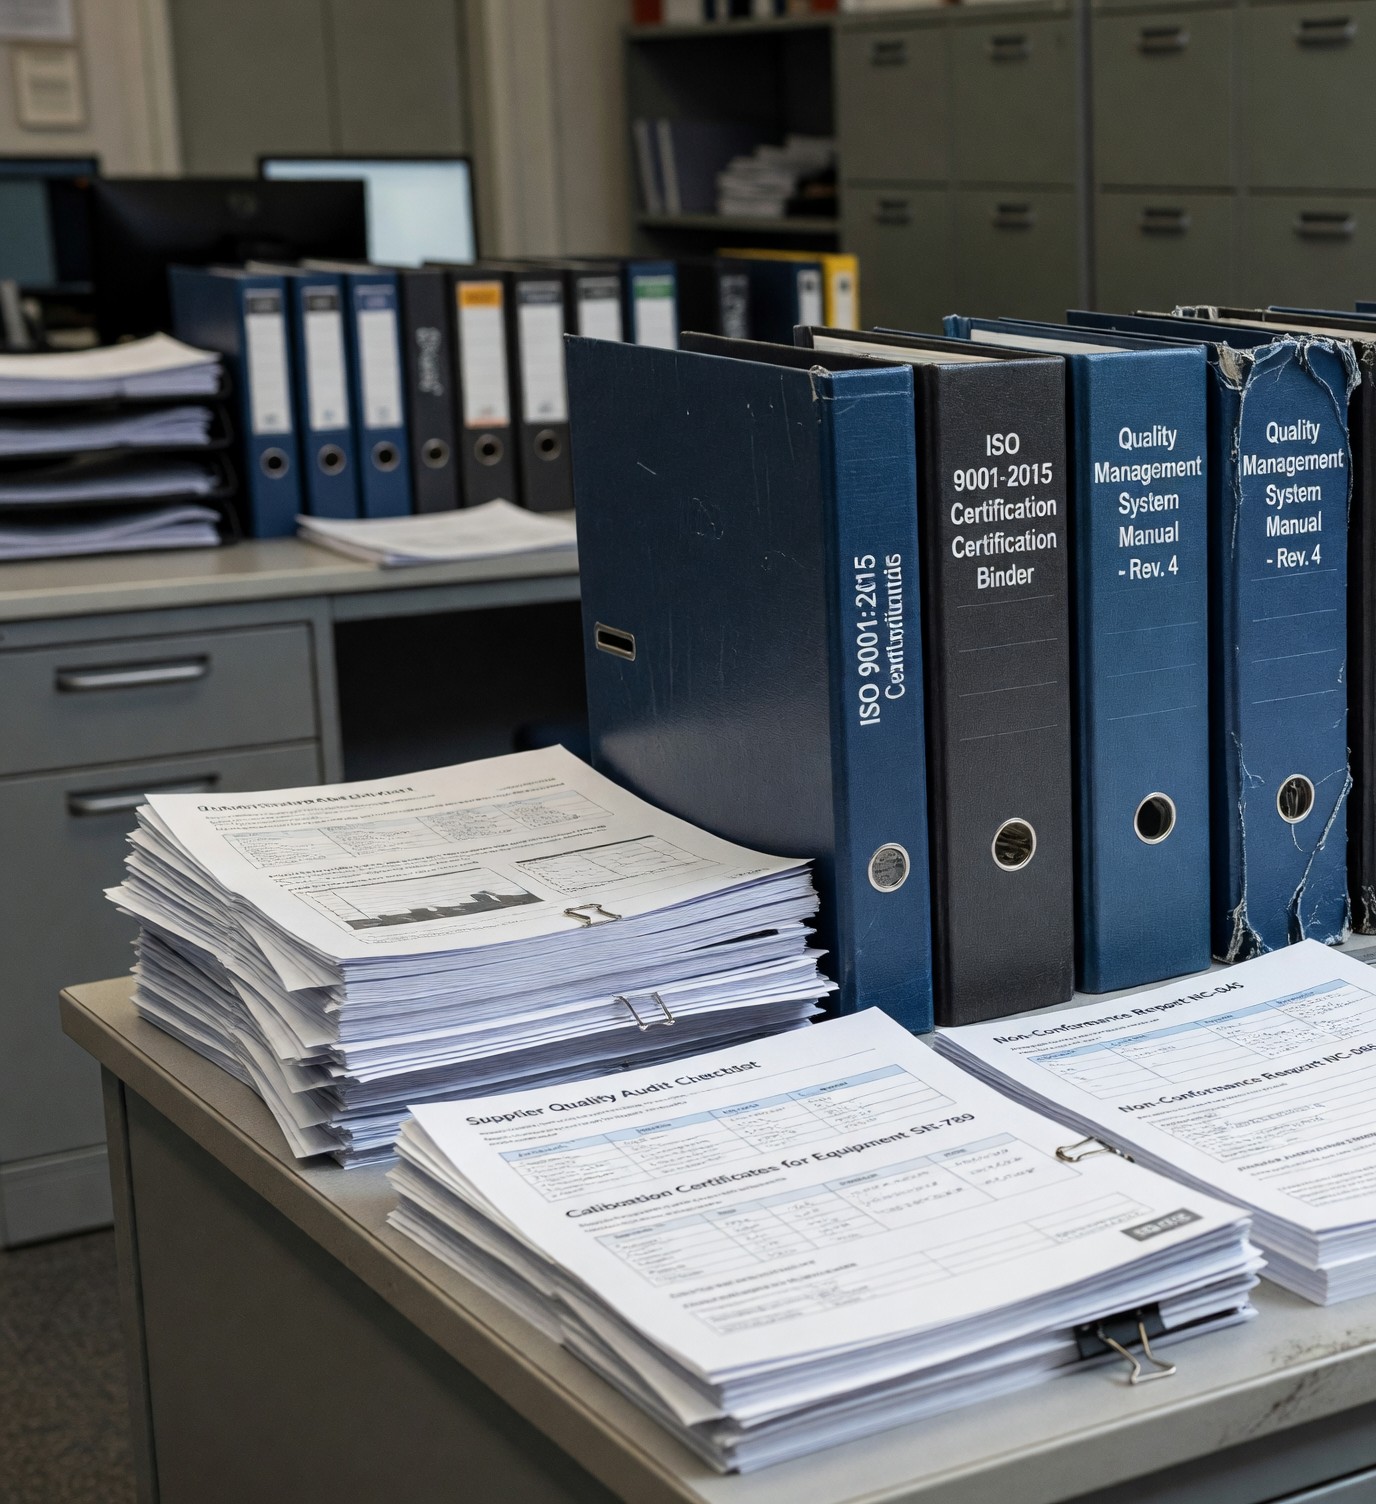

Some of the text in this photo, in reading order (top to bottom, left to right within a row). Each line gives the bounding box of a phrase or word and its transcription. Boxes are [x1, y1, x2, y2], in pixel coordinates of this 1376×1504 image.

[986, 433, 1020, 457] ISO
[1119, 425, 1177, 450] Quality
[1266, 419, 1320, 445] Quality
[1094, 455, 1202, 485] Management
[1243, 449, 1344, 477] Management
[953, 463, 1053, 492] 9001-2015
[1119, 490, 1179, 518] System
[1266, 484, 1321, 509] System
[951, 497, 1057, 525] Certification
[1266, 511, 1322, 537] Manual
[952, 529, 1057, 559] Certification
[1119, 521, 1179, 548] Manual
[1129, 559, 1165, 580] Rev.
[1168, 555, 1179, 576] 4
[1277, 547, 1309, 569] Rev.
[1311, 544, 1322, 565] 4
[977, 564, 1034, 590] Binder
[859, 684, 881, 726] ISO
[548, 1093, 617, 1112] Quality
[621, 1081, 674, 1099] Audit
[780, 1156, 809, 1169] for
[811, 1130, 910, 1161] Equipment
